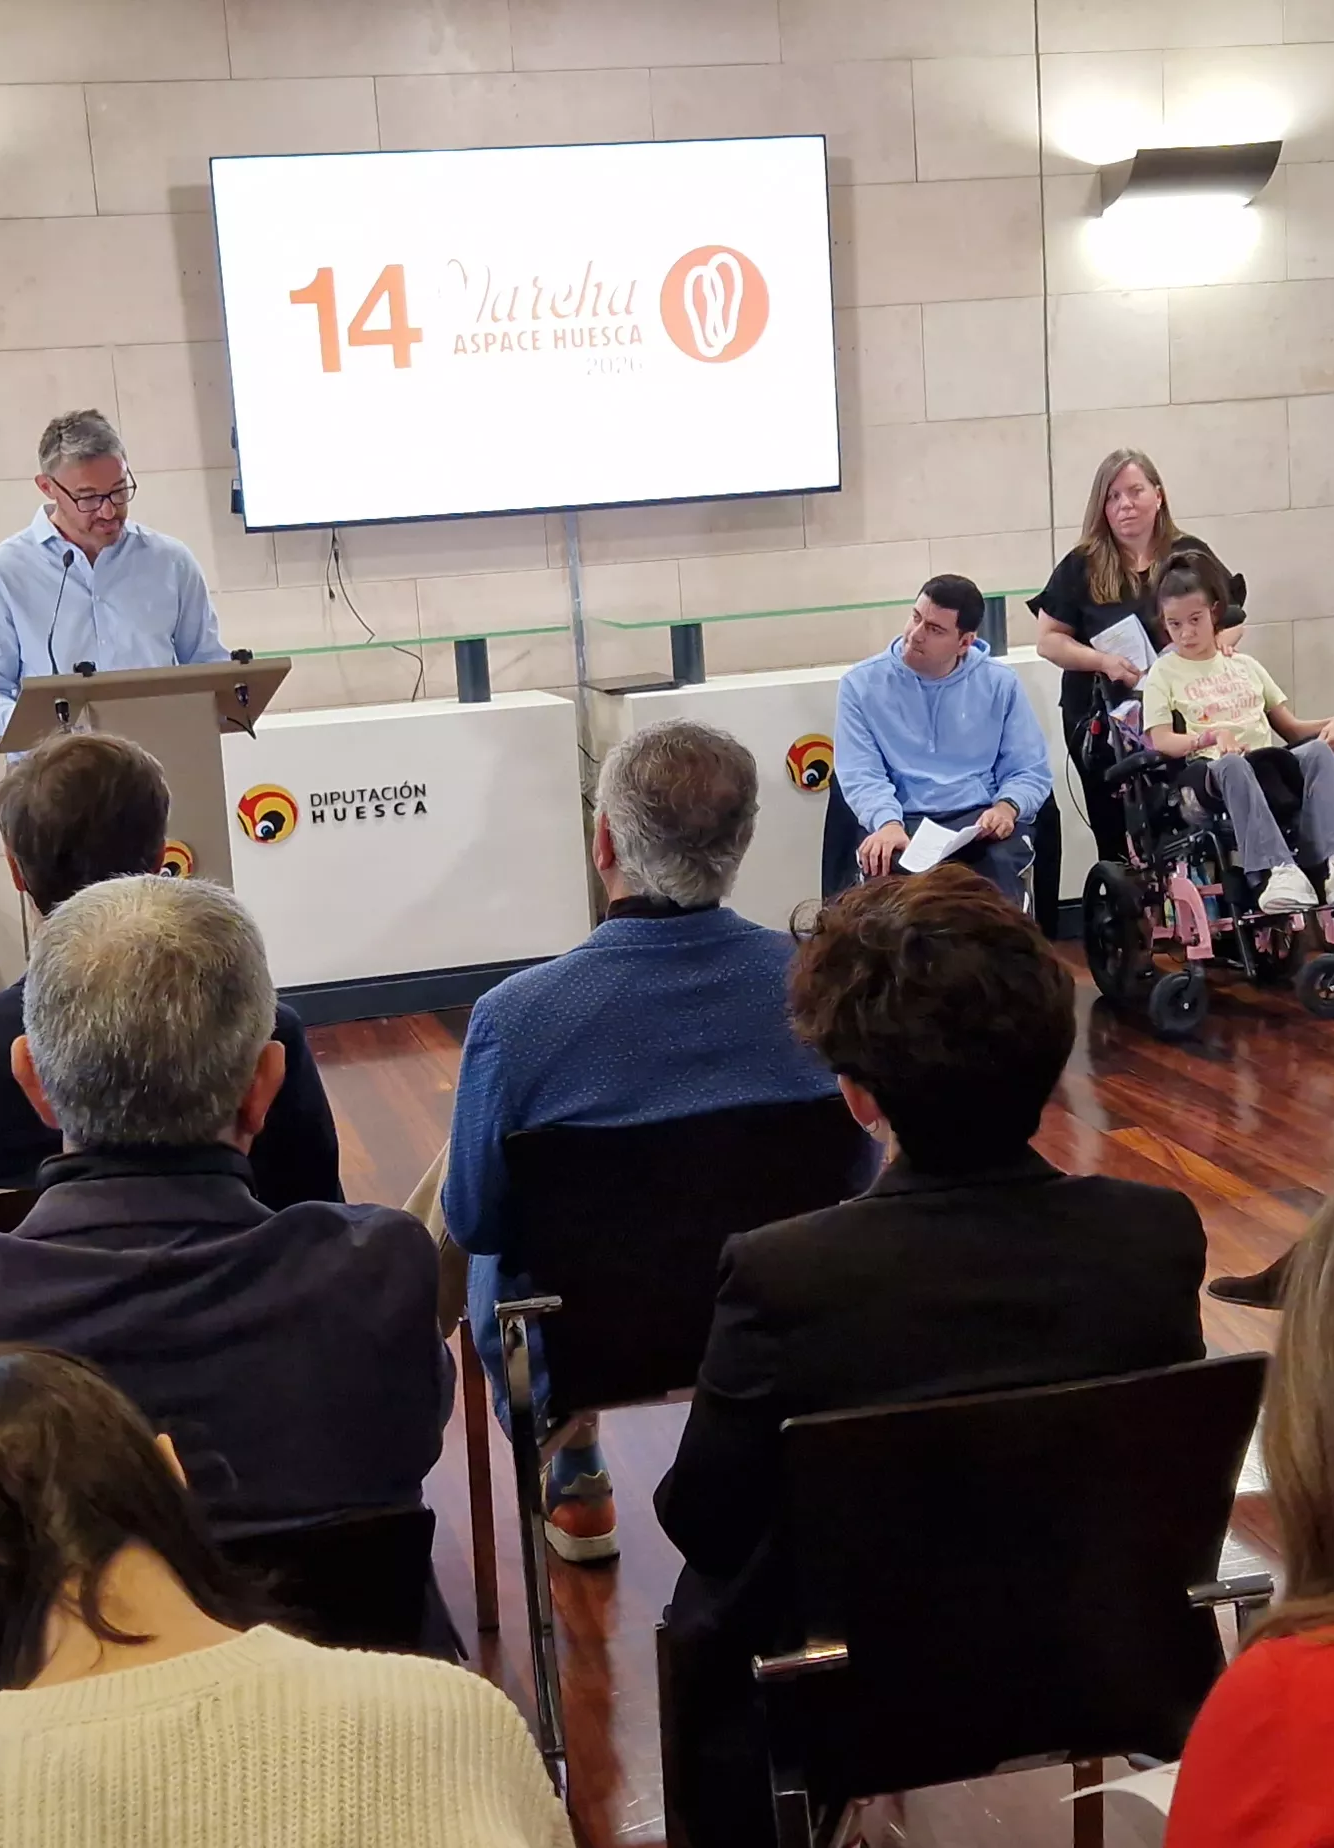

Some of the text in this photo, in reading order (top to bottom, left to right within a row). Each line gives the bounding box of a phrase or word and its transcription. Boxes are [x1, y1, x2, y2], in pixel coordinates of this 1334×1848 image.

[289, 263, 423, 373] 14
[454, 324, 643, 355] ASPACE HUESCA
[586, 356, 643, 375] 2026
[310, 780, 427, 807] DIPUTACIÓN
[312, 801, 428, 824] HUESCA
